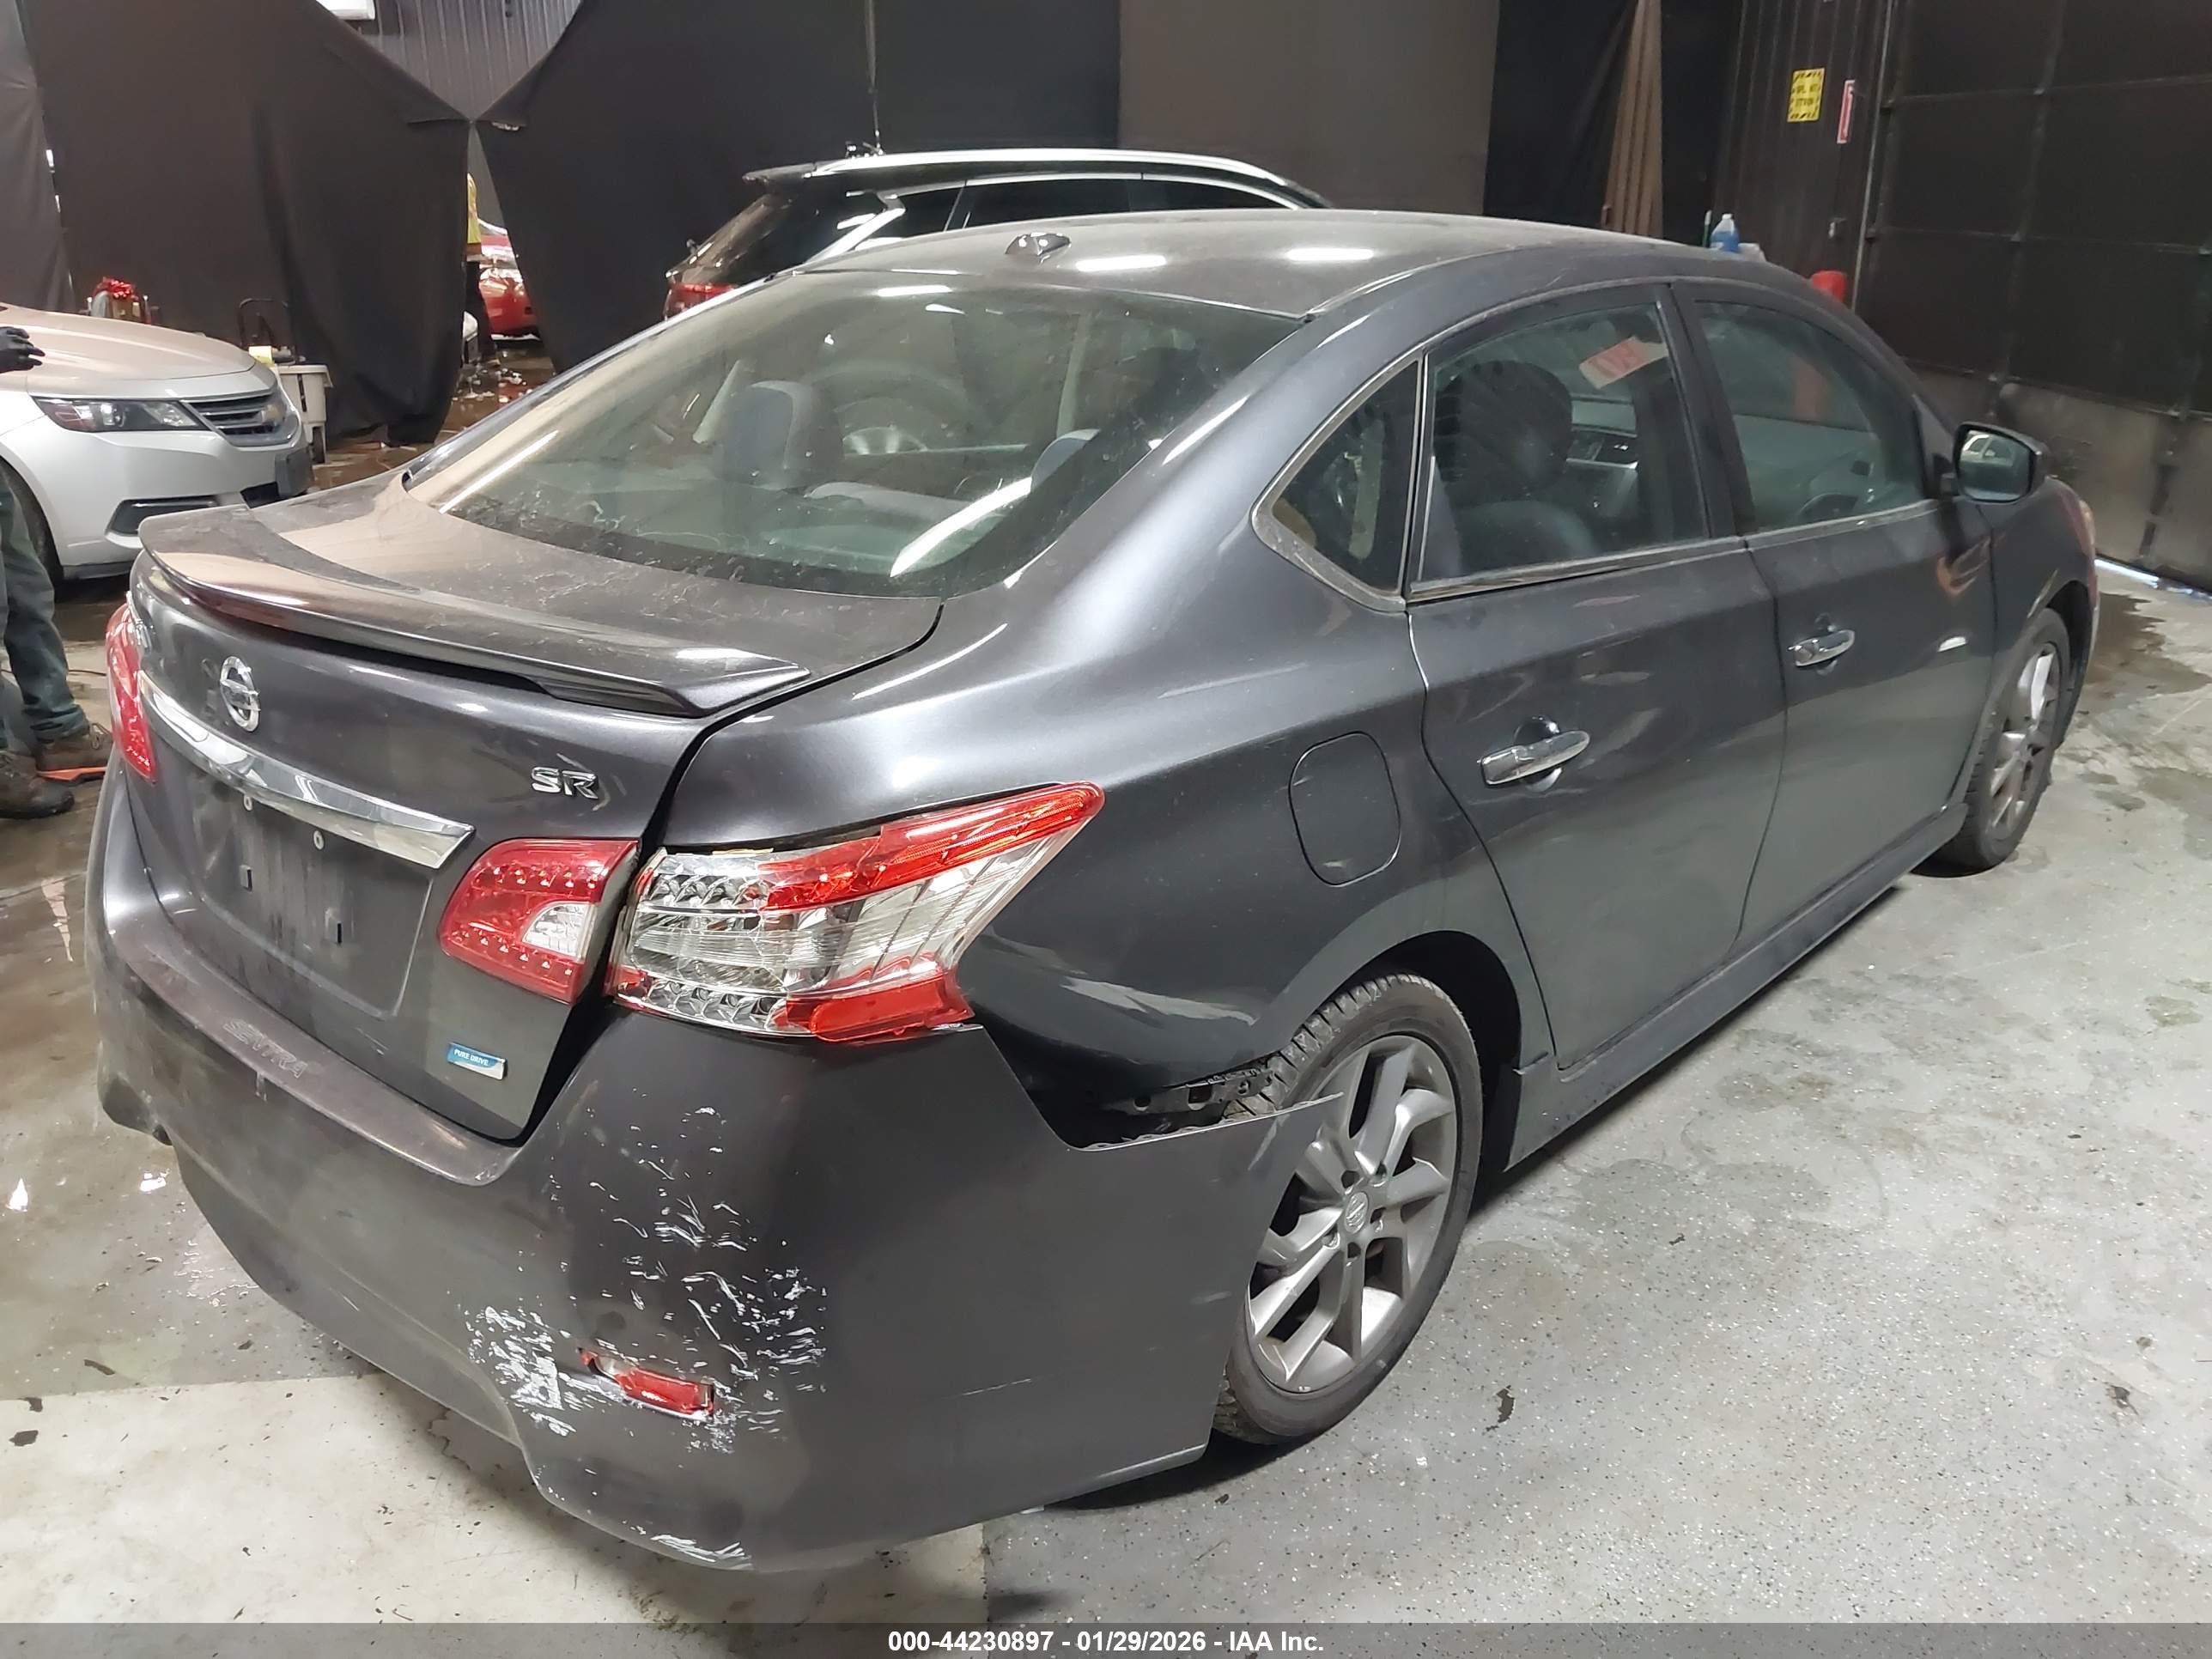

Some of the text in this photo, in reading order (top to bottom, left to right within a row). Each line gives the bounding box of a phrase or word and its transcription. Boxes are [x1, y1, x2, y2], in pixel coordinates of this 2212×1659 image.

[532, 767, 599, 799] SR
[453, 1048, 489, 1066] PURE DRIVE
